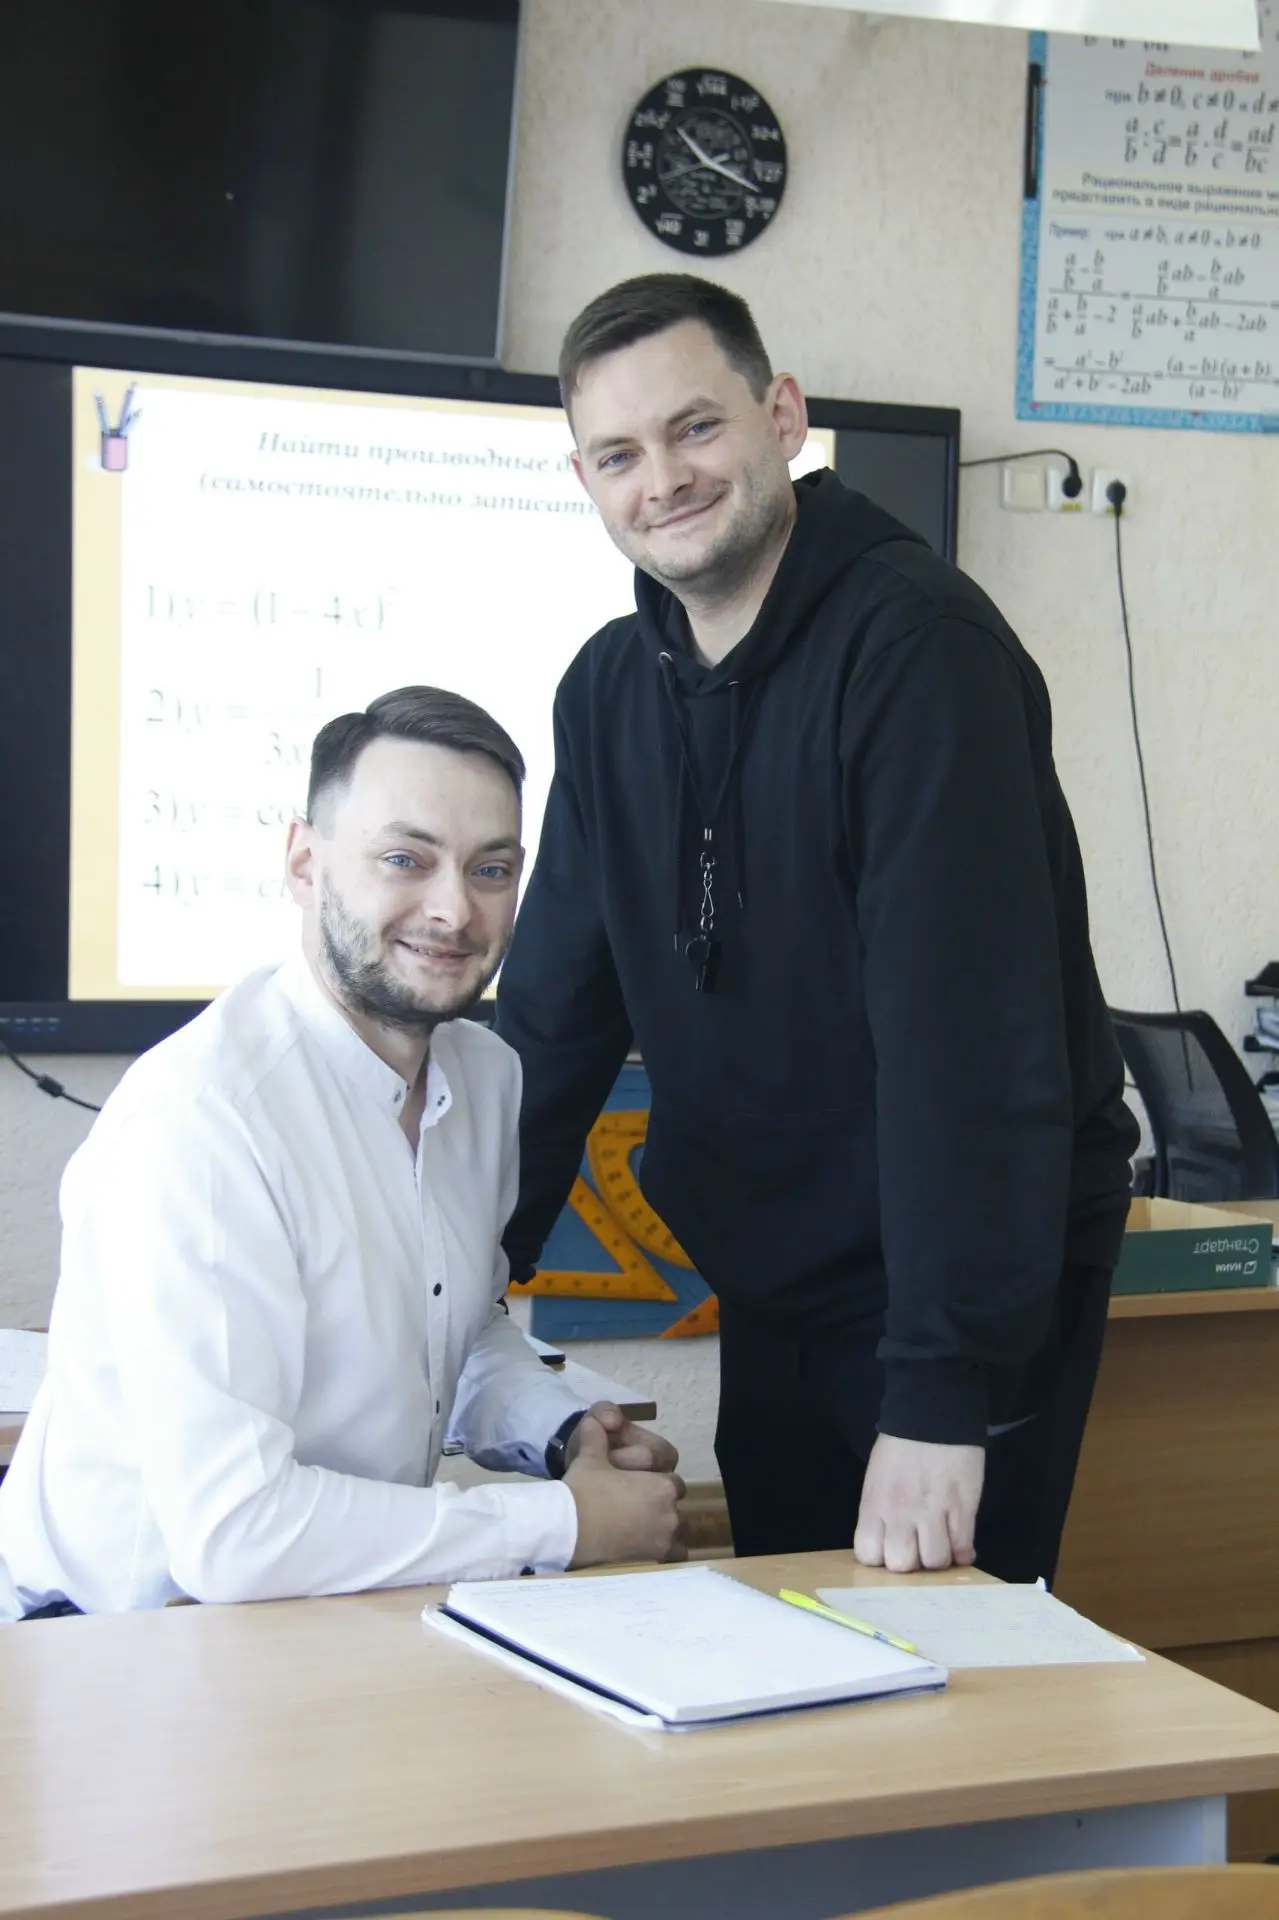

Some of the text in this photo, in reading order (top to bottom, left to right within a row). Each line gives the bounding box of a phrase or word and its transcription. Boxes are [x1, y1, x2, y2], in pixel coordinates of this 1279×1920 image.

[257, 430, 359, 459] Найти
[366, 444, 549, 473] производные
[199, 468, 462, 506] (самостоятельно
[1192, 1237, 1259, 1254] Стандарт
